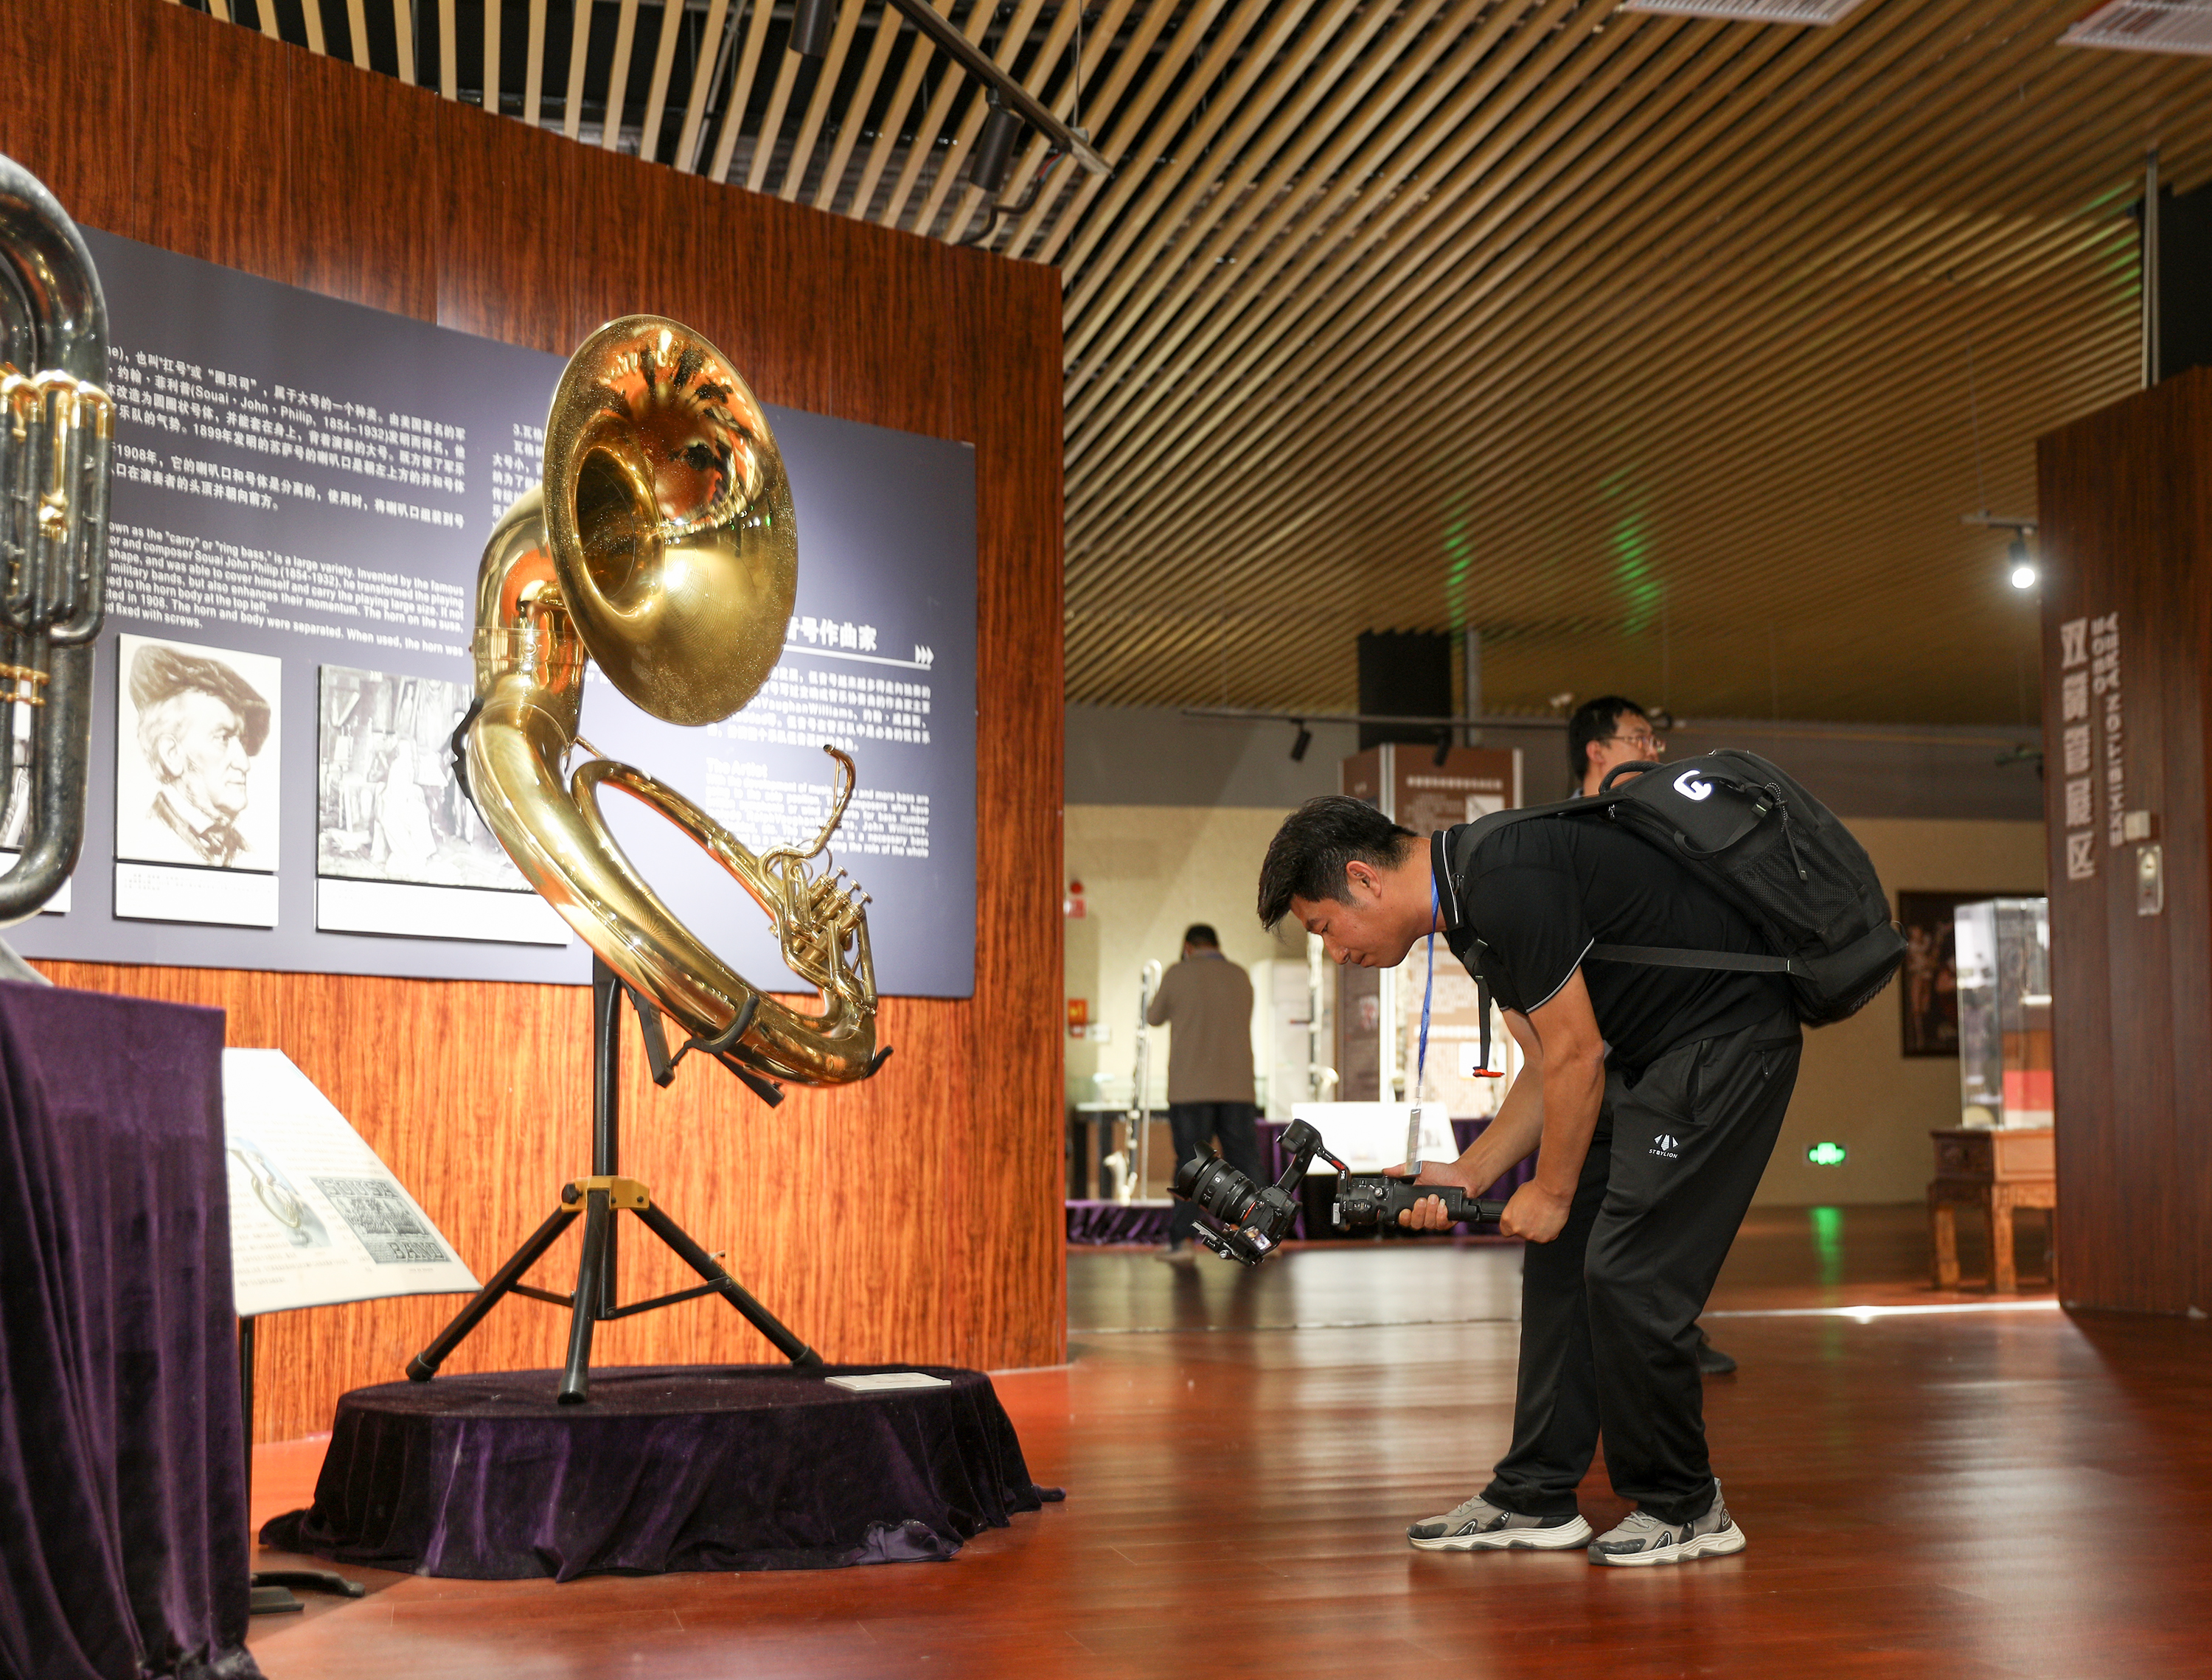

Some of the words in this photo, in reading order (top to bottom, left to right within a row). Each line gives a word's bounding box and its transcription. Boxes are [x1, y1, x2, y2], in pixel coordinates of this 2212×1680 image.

[107, 548, 142, 565] shape,
[145, 556, 164, 569] and
[165, 557, 187, 573] was
[188, 563, 211, 577] able
[212, 565, 223, 579] to
[224, 568, 252, 584] cover
[254, 574, 290, 590] himself
[291, 582, 309, 595] and
[310, 586, 335, 601] carry
[337, 588, 353, 602] the
[355, 593, 389, 610] playing
[390, 599, 414, 613] large
[440, 607, 447, 617] It
[449, 610, 463, 620] not
[108, 535, 121, 546] or
[122, 538, 142, 551] and
[142, 543, 193, 560] composer
[224, 556, 249, 571] John
[250, 560, 279, 577] Philip
[343, 576, 355, 590] he
[356, 581, 413, 599] transformed
[414, 590, 429, 602] the
[431, 594, 464, 611] playing
[123, 576, 134, 590] to
[135, 579, 152, 593] the
[153, 582, 176, 597] horn
[177, 587, 203, 604] body
[203, 593, 214, 604] at
[215, 593, 232, 607] the
[232, 596, 249, 611] top
[131, 526, 144, 538] as
[146, 528, 163, 542] the
[201, 540, 213, 551] or
[274, 551, 282, 565] is
[284, 556, 291, 566] a
[293, 556, 318, 571] large
[357, 568, 398, 585] Invented
[400, 575, 411, 590] by
[413, 578, 428, 590] the
[431, 580, 464, 596] famous
[110, 562, 148, 581] military
[150, 568, 185, 588] bands,
[188, 575, 204, 590] but
[206, 579, 229, 593] also
[230, 585, 278, 602] enhances
[280, 593, 303, 606] their
[363, 605, 381, 618] The
[383, 609, 405, 622] horn
[407, 615, 419, 624] on
[421, 616, 437, 627] the
[115, 602, 140, 618] fixed
[141, 608, 163, 621] with
[127, 590, 137, 604] in
[170, 599, 191, 613] The
[193, 602, 216, 617] horn
[218, 609, 237, 621] and
[240, 610, 264, 627] body
[266, 617, 291, 630] were
[346, 628, 374, 642] When
[376, 635, 402, 647] used,
[405, 638, 420, 649] the
[422, 641, 442, 652] horn
[445, 646, 464, 656] was
[2104, 610, 2121, 689] AREA
[2106, 693, 2126, 848] EXHIBITION
[317, 1177, 399, 1198] SOUSA
[386, 1240, 446, 1262] BAND
